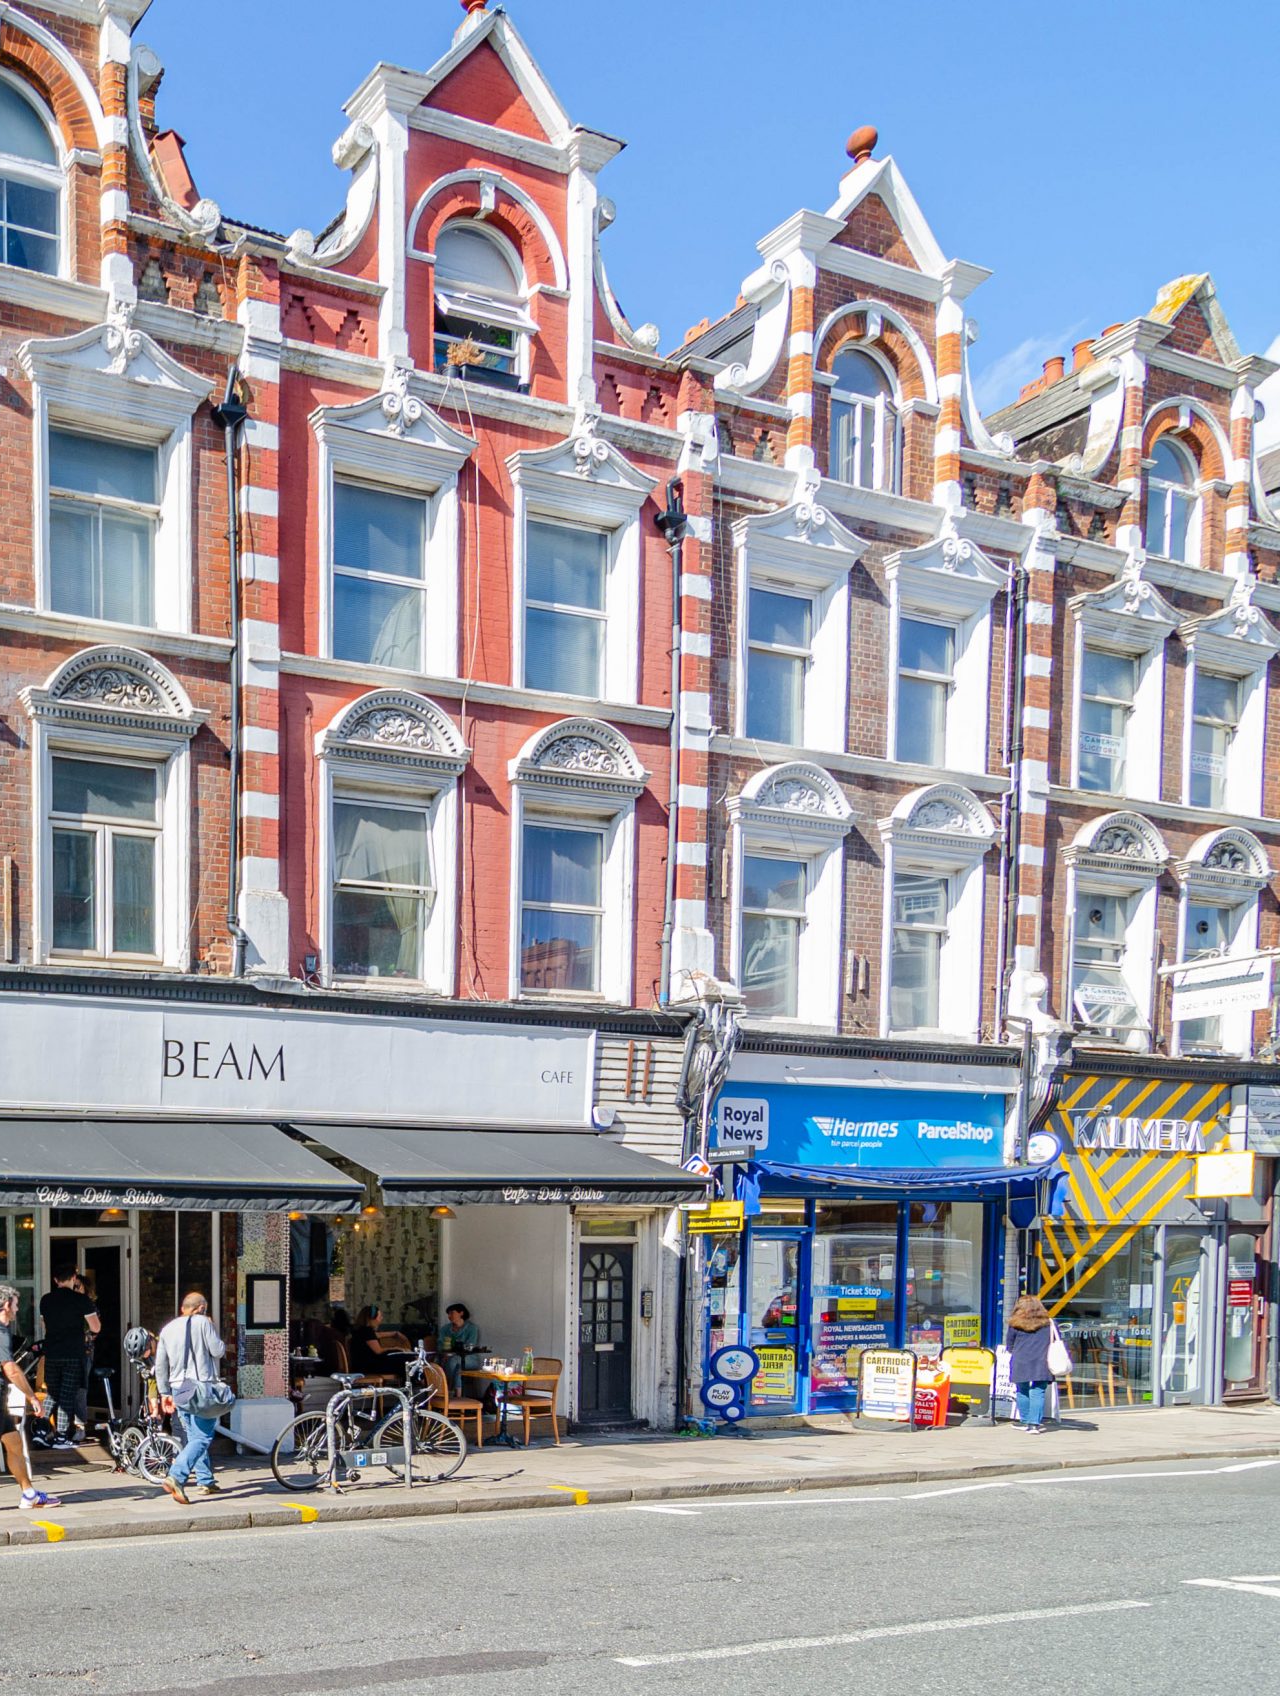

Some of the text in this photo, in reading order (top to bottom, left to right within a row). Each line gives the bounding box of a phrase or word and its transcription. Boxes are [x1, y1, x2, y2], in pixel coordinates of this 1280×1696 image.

[163, 1039, 286, 1082] BEAM
[541, 1070, 573, 1084] CAFE
[723, 1105, 763, 1125] Royal
[723, 1125, 763, 1141] News
[833, 1117, 993, 1144] Hermes ParcelShop
[1073, 1116, 1207, 1152] KALIMERA
[860, 1140, 883, 1149] people
[36, 1186, 165, 1206] Cafe Deli Bistro
[502, 1186, 604, 1204] Cafe Deli Bistro
[840, 1286, 863, 1296] Ticket
[864, 1286, 882, 1297] Stop
[1171, 1277, 1193, 1300] 43
[823, 1323, 885, 1333] ROYAL NEWSAGENTS
[946, 1318, 979, 1328] CARTRIDGE
[954, 1328, 971, 1338] REFILL
[1130, 1327, 1151, 1336] food
[866, 1356, 911, 1367] CARTRIDGE
[876, 1366, 900, 1375] REFILL
[356, 1454, 364, 1466] P
